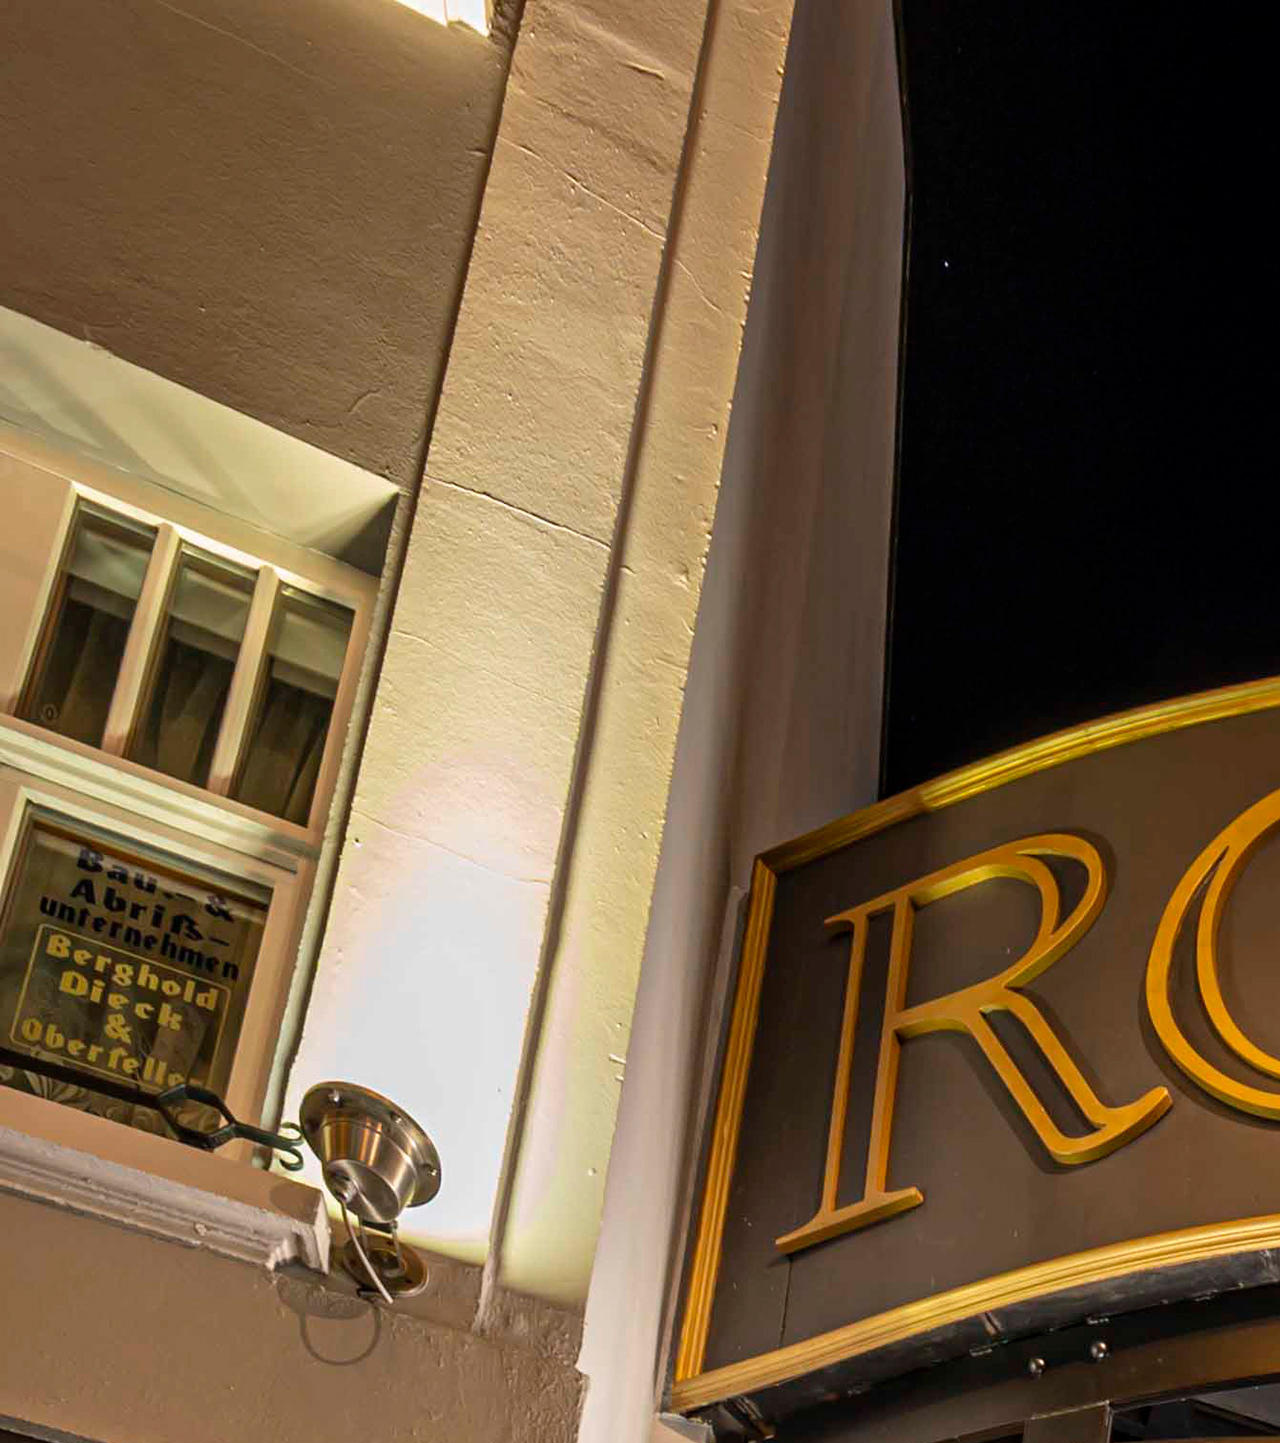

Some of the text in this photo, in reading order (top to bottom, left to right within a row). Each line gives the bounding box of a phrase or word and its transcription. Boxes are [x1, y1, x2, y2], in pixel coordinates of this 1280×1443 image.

[39, 896, 240, 982] unternehmen
[46, 933, 219, 1011] Berghold
[59, 969, 183, 1032] Dieck
[105, 1013, 132, 1046] &
